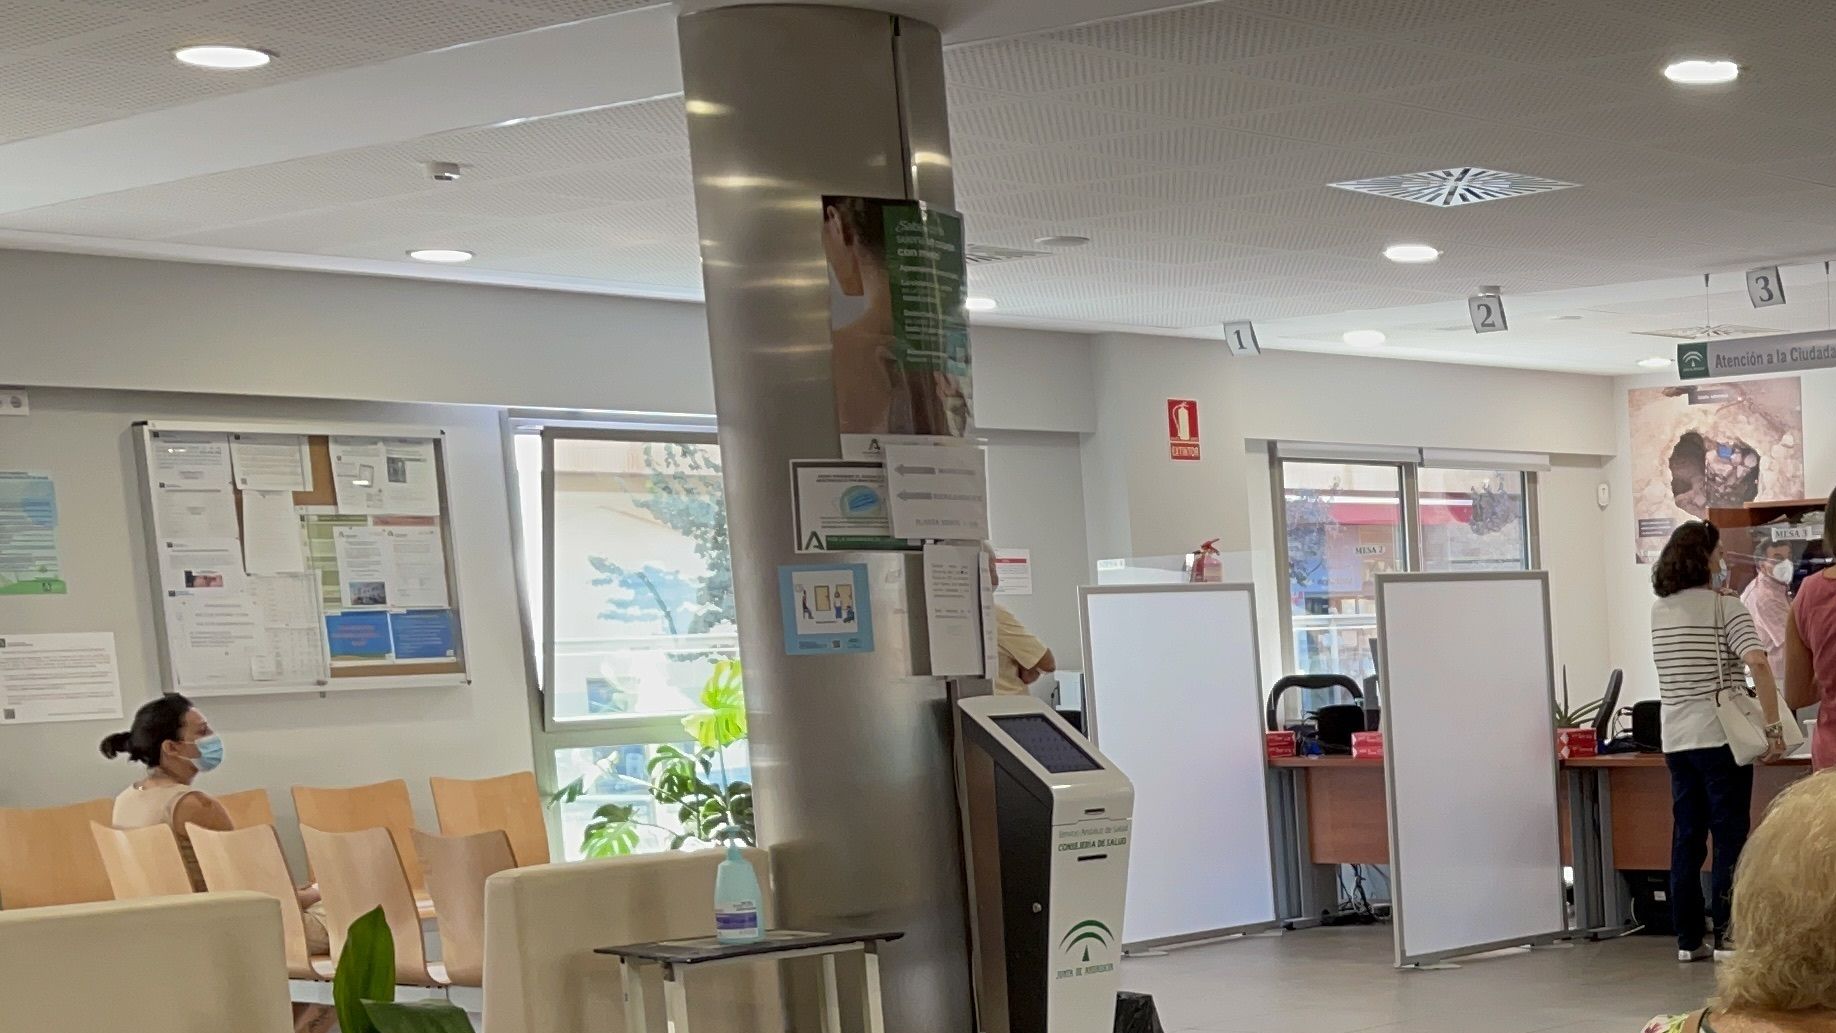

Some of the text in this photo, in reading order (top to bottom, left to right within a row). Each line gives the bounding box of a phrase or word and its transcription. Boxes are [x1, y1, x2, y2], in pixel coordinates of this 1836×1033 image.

[1755, 275, 1774, 302] 3
[1477, 303, 1496, 328] 2
[1234, 329, 1247, 350] 1
[1715, 350, 1764, 369] Atención
[1767, 354, 1775, 365] a
[1777, 349, 1787, 364] la
[1173, 445, 1199, 458] EXTINTOR
[1097, 839, 1105, 848] DE
[1106, 837, 1127, 846] SALUD
